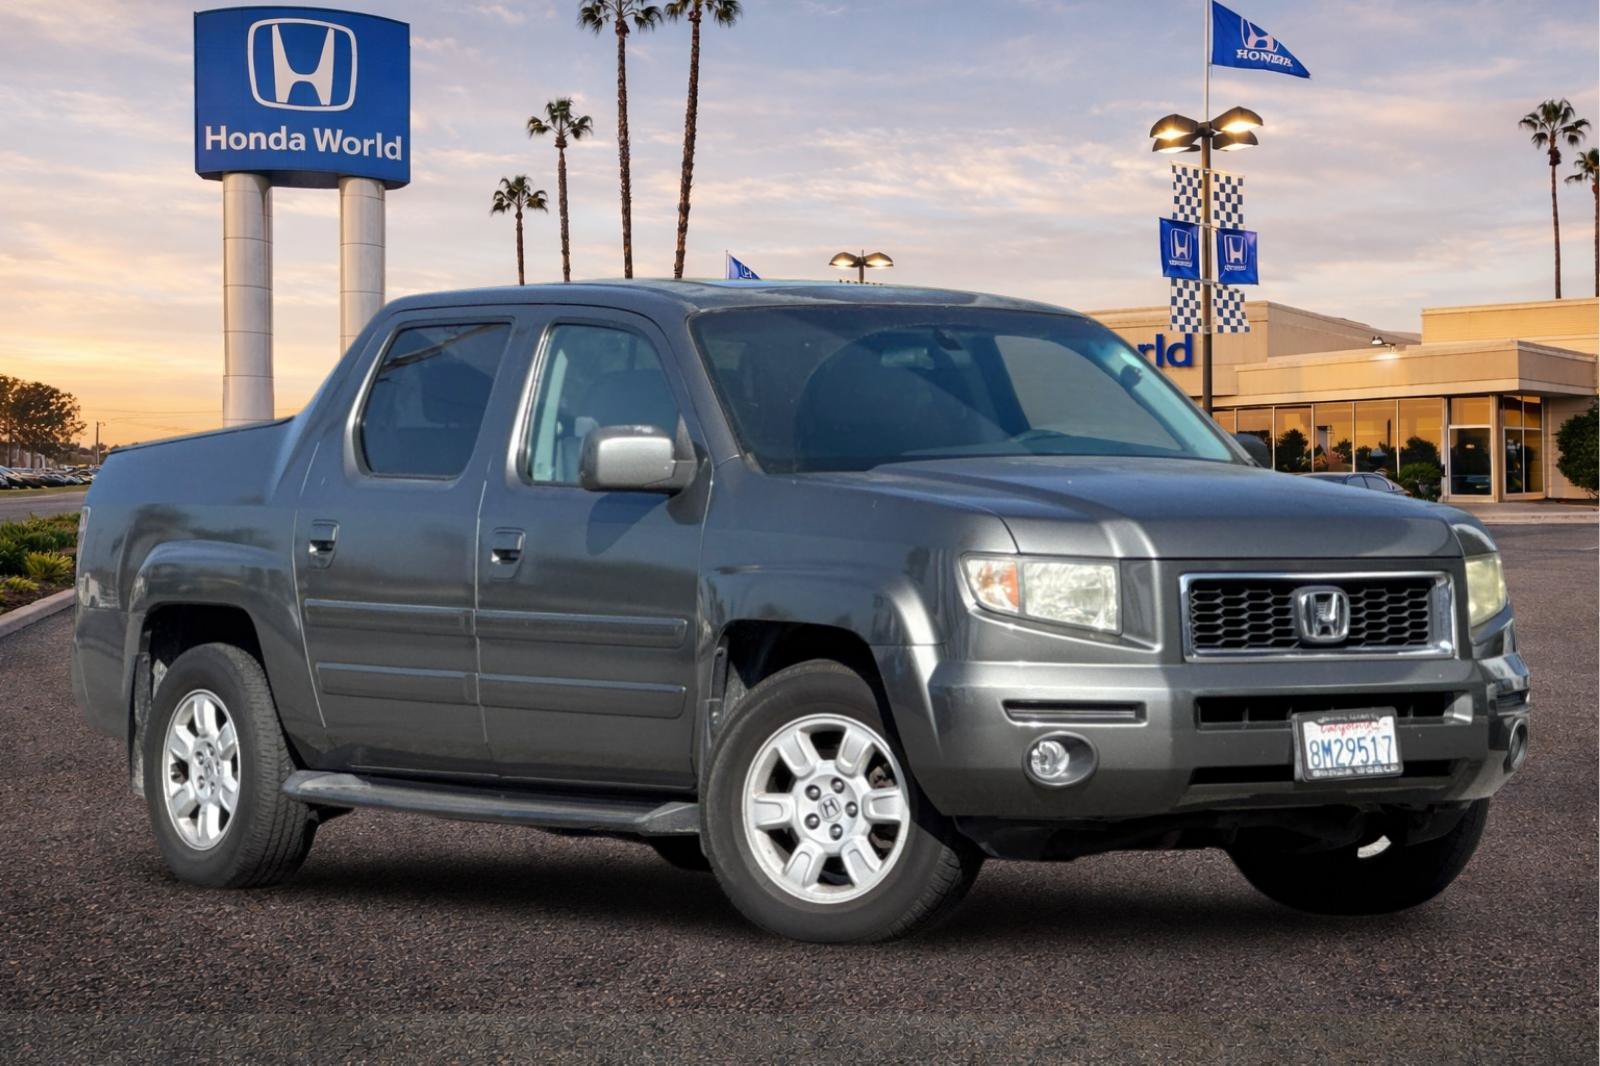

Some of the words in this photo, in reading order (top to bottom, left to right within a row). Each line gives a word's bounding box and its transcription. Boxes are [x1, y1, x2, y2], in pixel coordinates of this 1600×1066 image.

[205, 125, 306, 151] Honda
[313, 127, 403, 161] World
[1309, 735, 1393, 769] 8M29517
